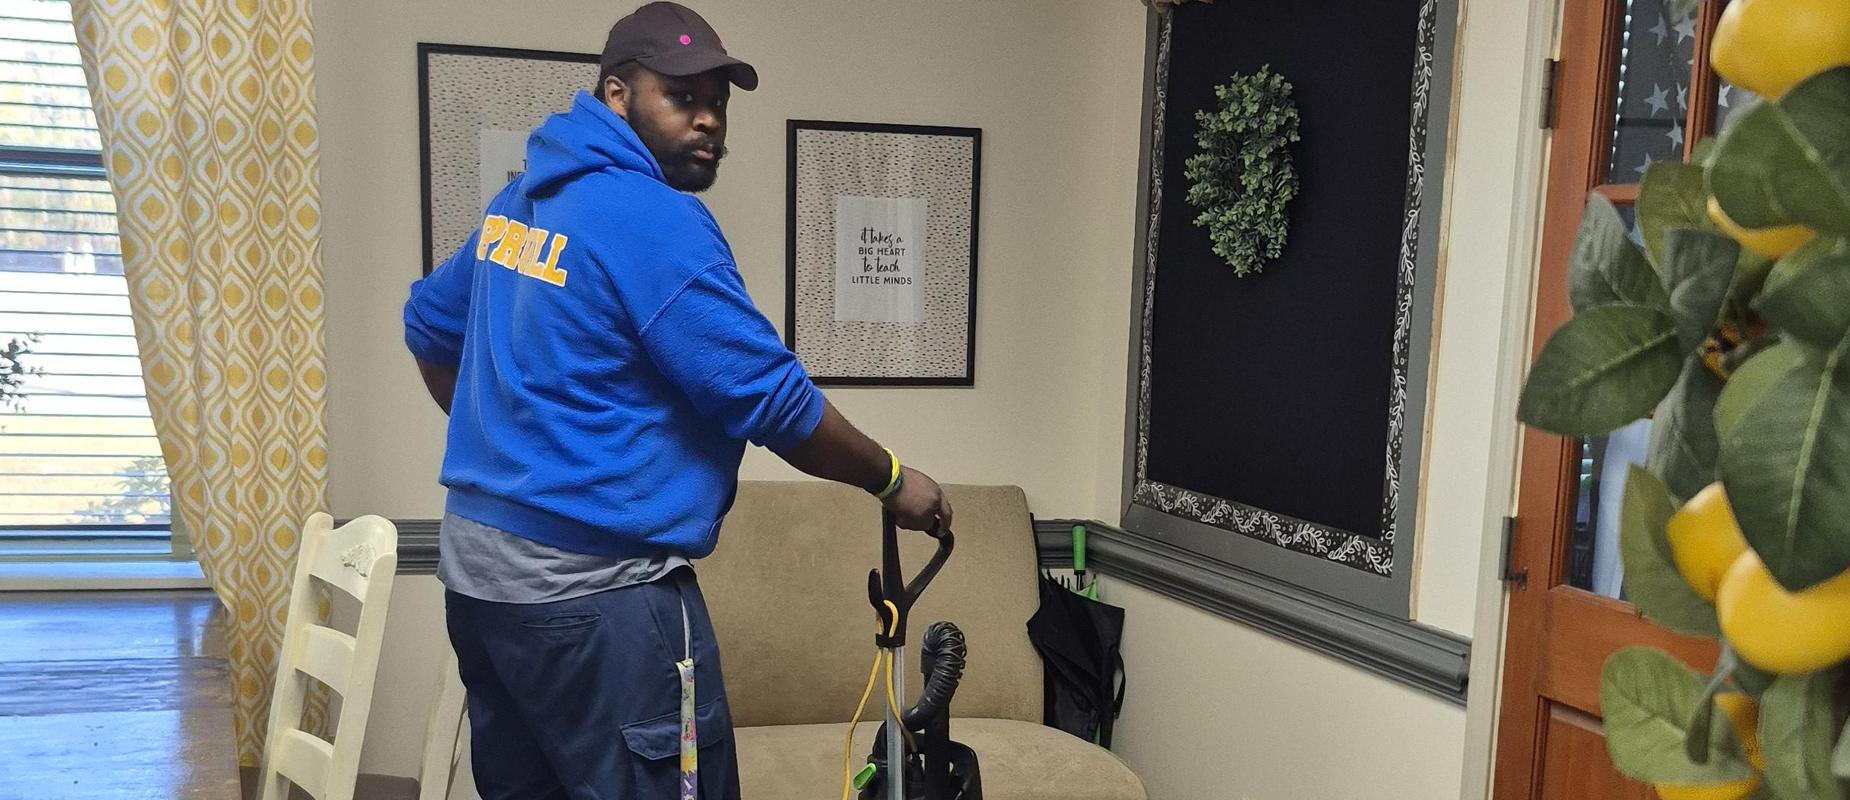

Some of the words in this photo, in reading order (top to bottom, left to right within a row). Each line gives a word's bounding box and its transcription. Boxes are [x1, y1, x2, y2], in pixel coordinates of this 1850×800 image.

[868, 227, 893, 247] takes
[858, 247, 873, 255] BIG
[877, 247, 906, 256] HEART
[861, 256, 873, 273] to
[874, 256, 900, 273] teach
[852, 276, 880, 284] LITTLE
[883, 277, 913, 285] MINDS
